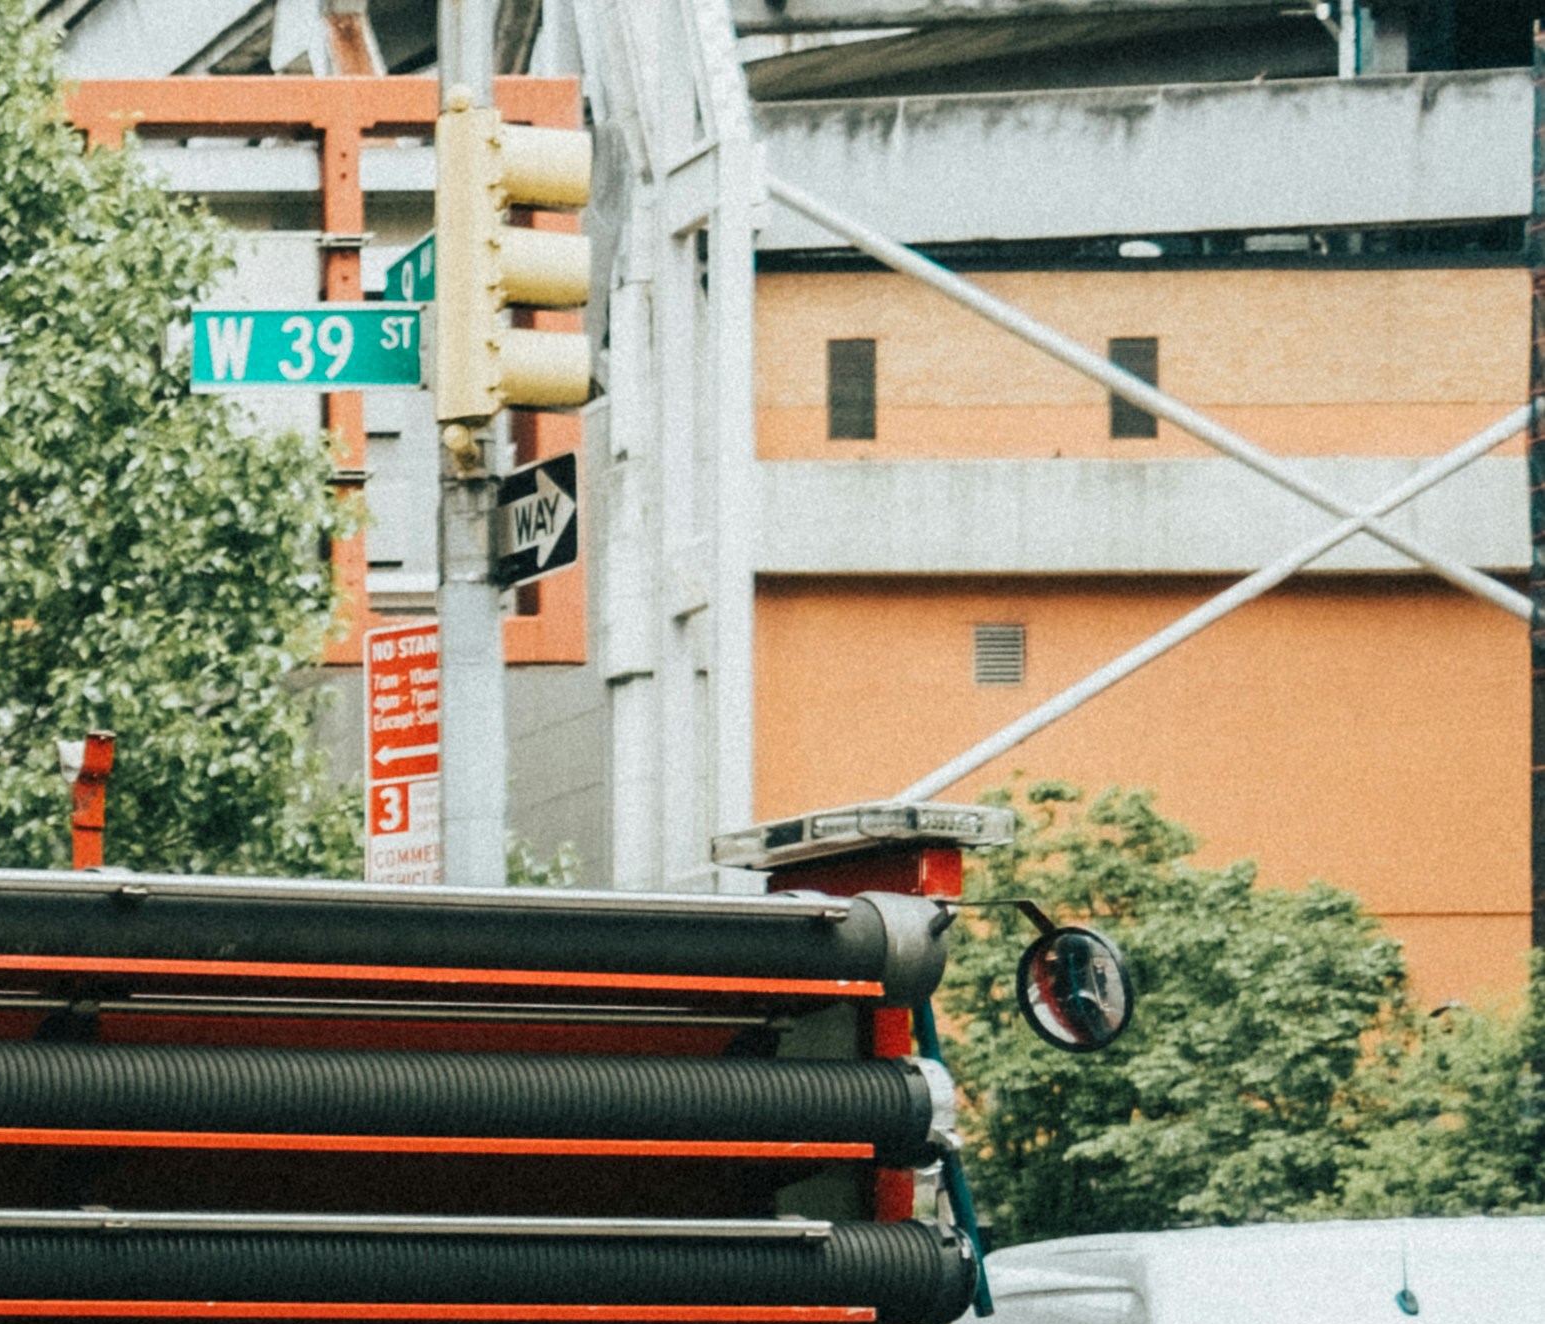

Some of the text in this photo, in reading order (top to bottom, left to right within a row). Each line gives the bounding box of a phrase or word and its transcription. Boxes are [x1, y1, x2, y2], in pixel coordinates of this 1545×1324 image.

[207, 314, 416, 382] W 39 ST
[514, 493, 561, 546] WAY
[372, 634, 438, 662] NO STAN
[378, 785, 403, 832] 3
